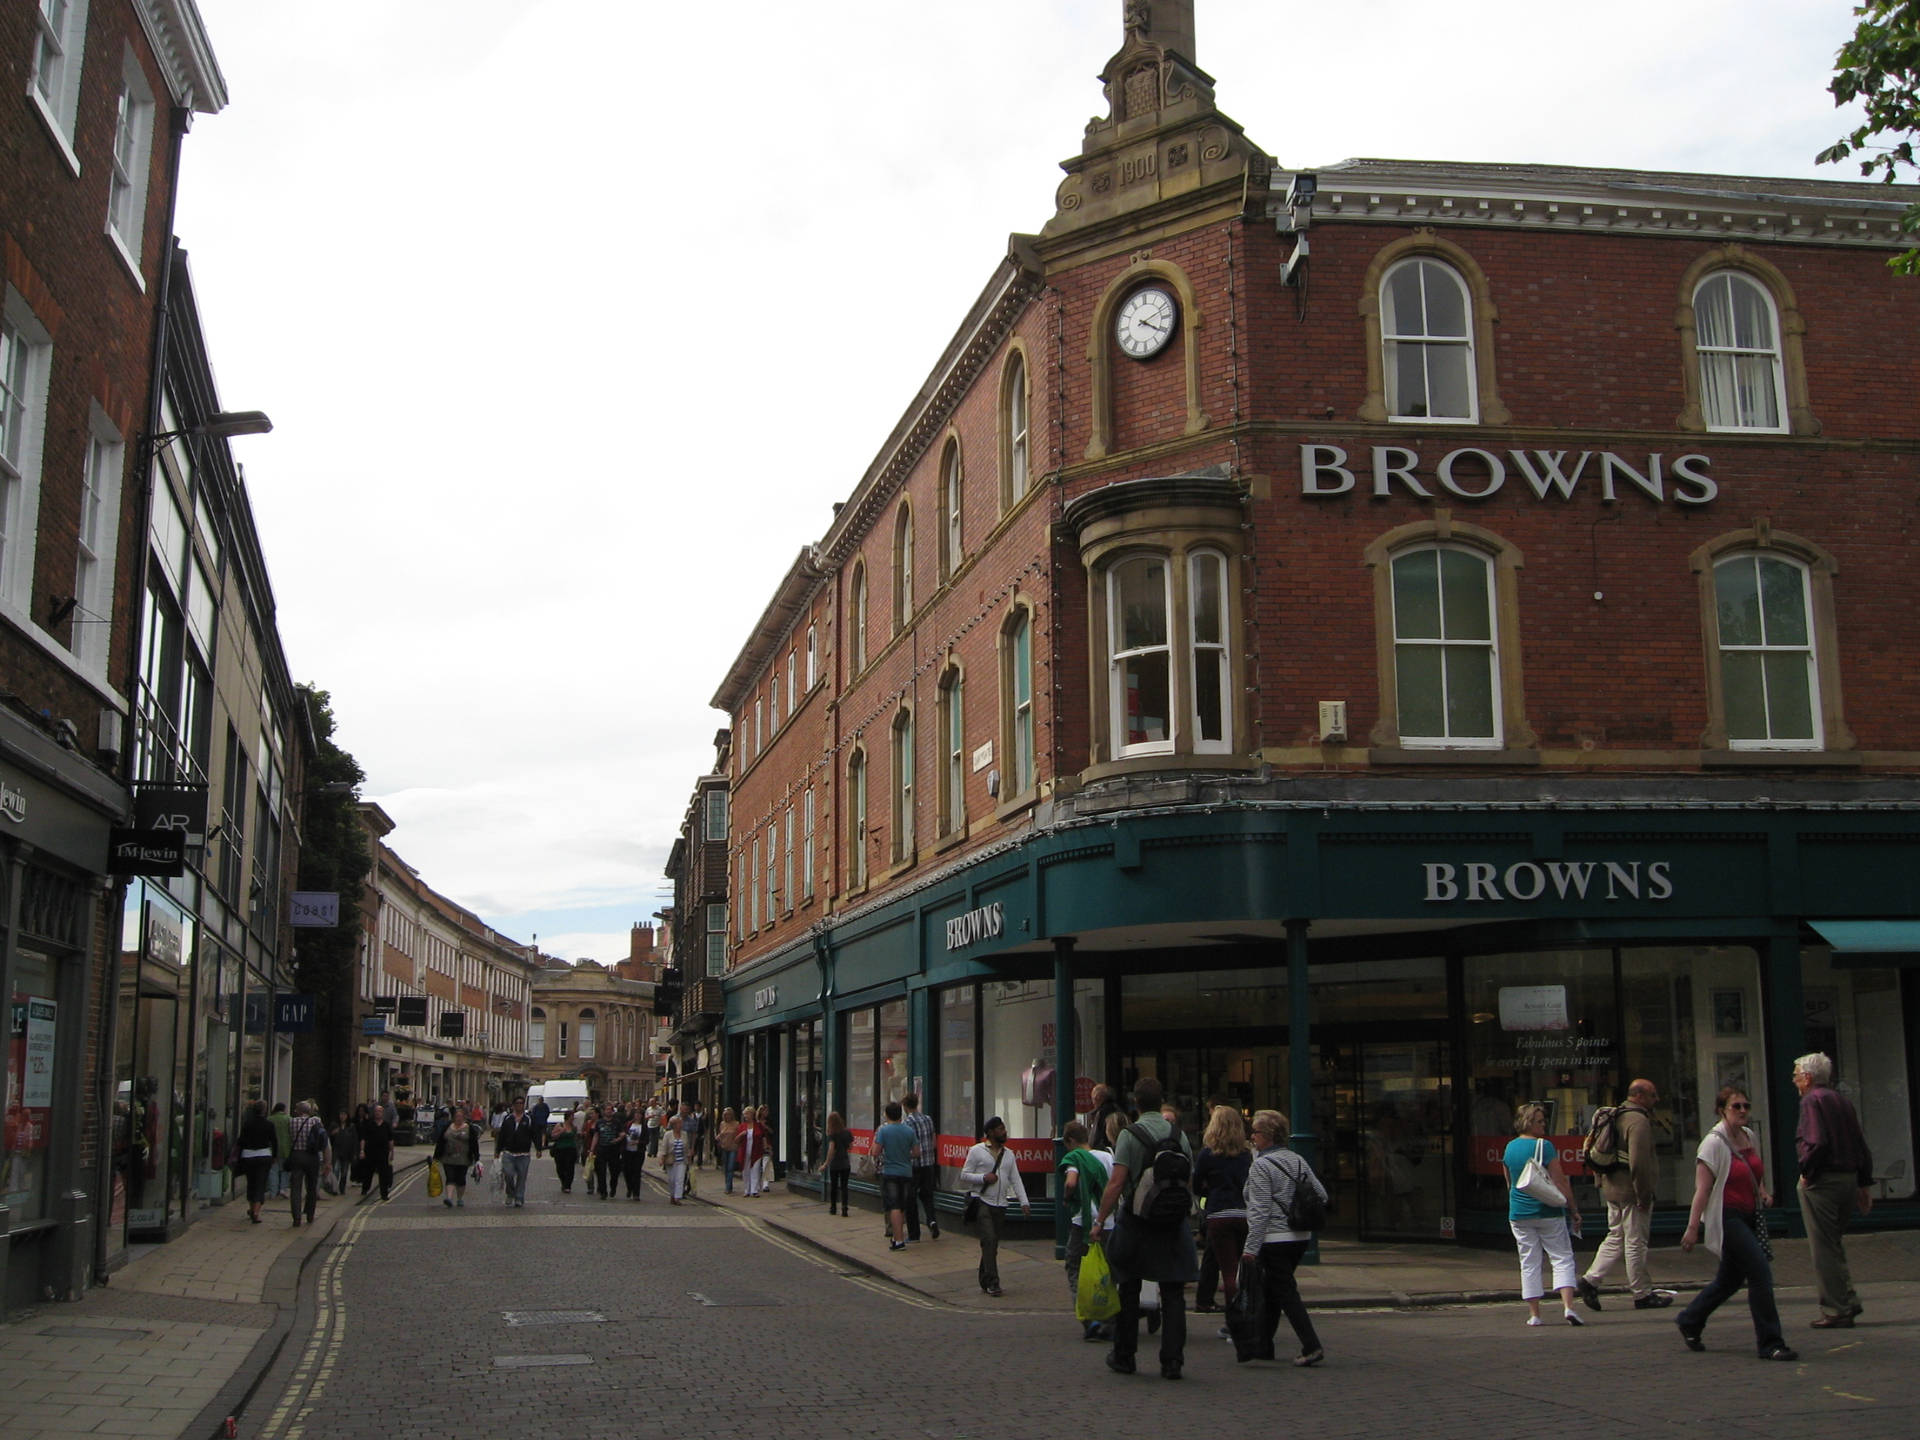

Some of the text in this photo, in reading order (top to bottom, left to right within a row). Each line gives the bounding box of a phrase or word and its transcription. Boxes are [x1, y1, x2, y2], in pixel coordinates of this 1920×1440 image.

[1119, 152, 1156, 188] 1900
[1299, 444, 1718, 504] BROWNS
[1422, 861, 1673, 901] BROWNS
[946, 902, 1001, 950] BROWNS
[282, 1003, 308, 1022] GAP
[1515, 1036, 1564, 1049] Fabulous
[1576, 1037, 1610, 1050] points
[1539, 1056, 1569, 1069] spent
[1571, 1055, 1581, 1065] in
[1584, 1056, 1611, 1065] store
